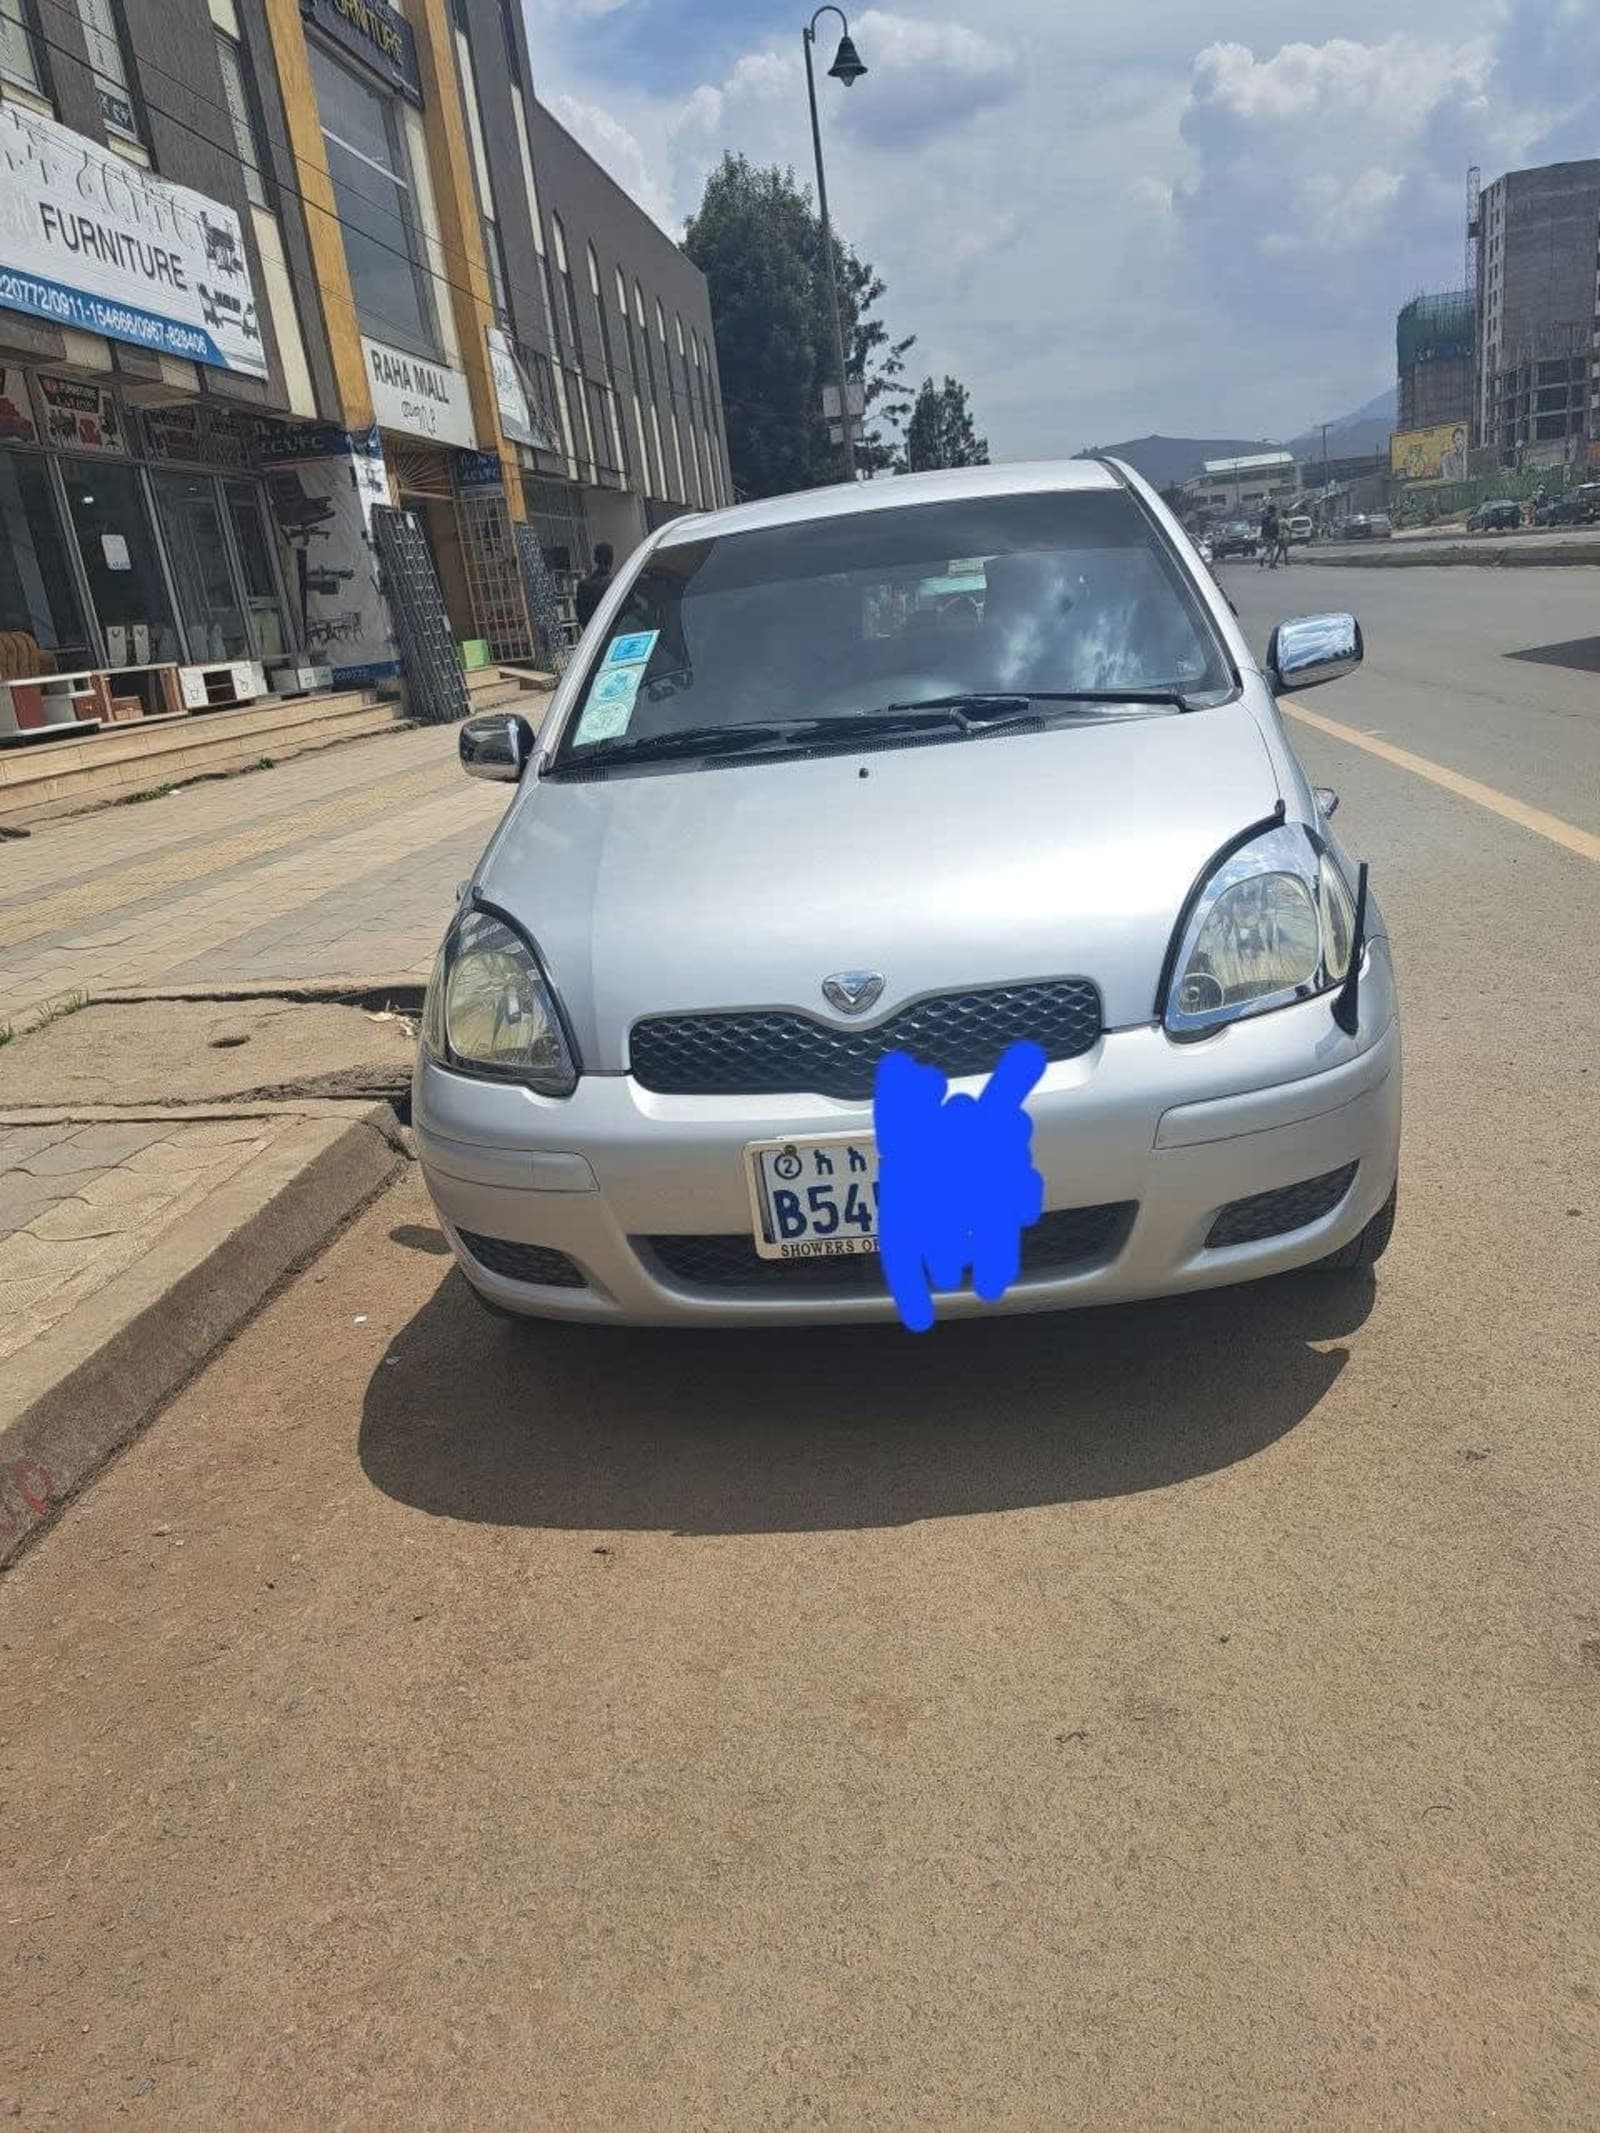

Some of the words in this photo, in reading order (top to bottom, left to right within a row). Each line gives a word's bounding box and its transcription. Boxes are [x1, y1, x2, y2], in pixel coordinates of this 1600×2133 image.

[38, 201, 188, 291] FURNITURE
[370, 350, 414, 393] RAHA
[413, 364, 450, 404] MALL
[773, 1182, 880, 1239] B54
[781, 1240, 855, 1257] SHOWERS
